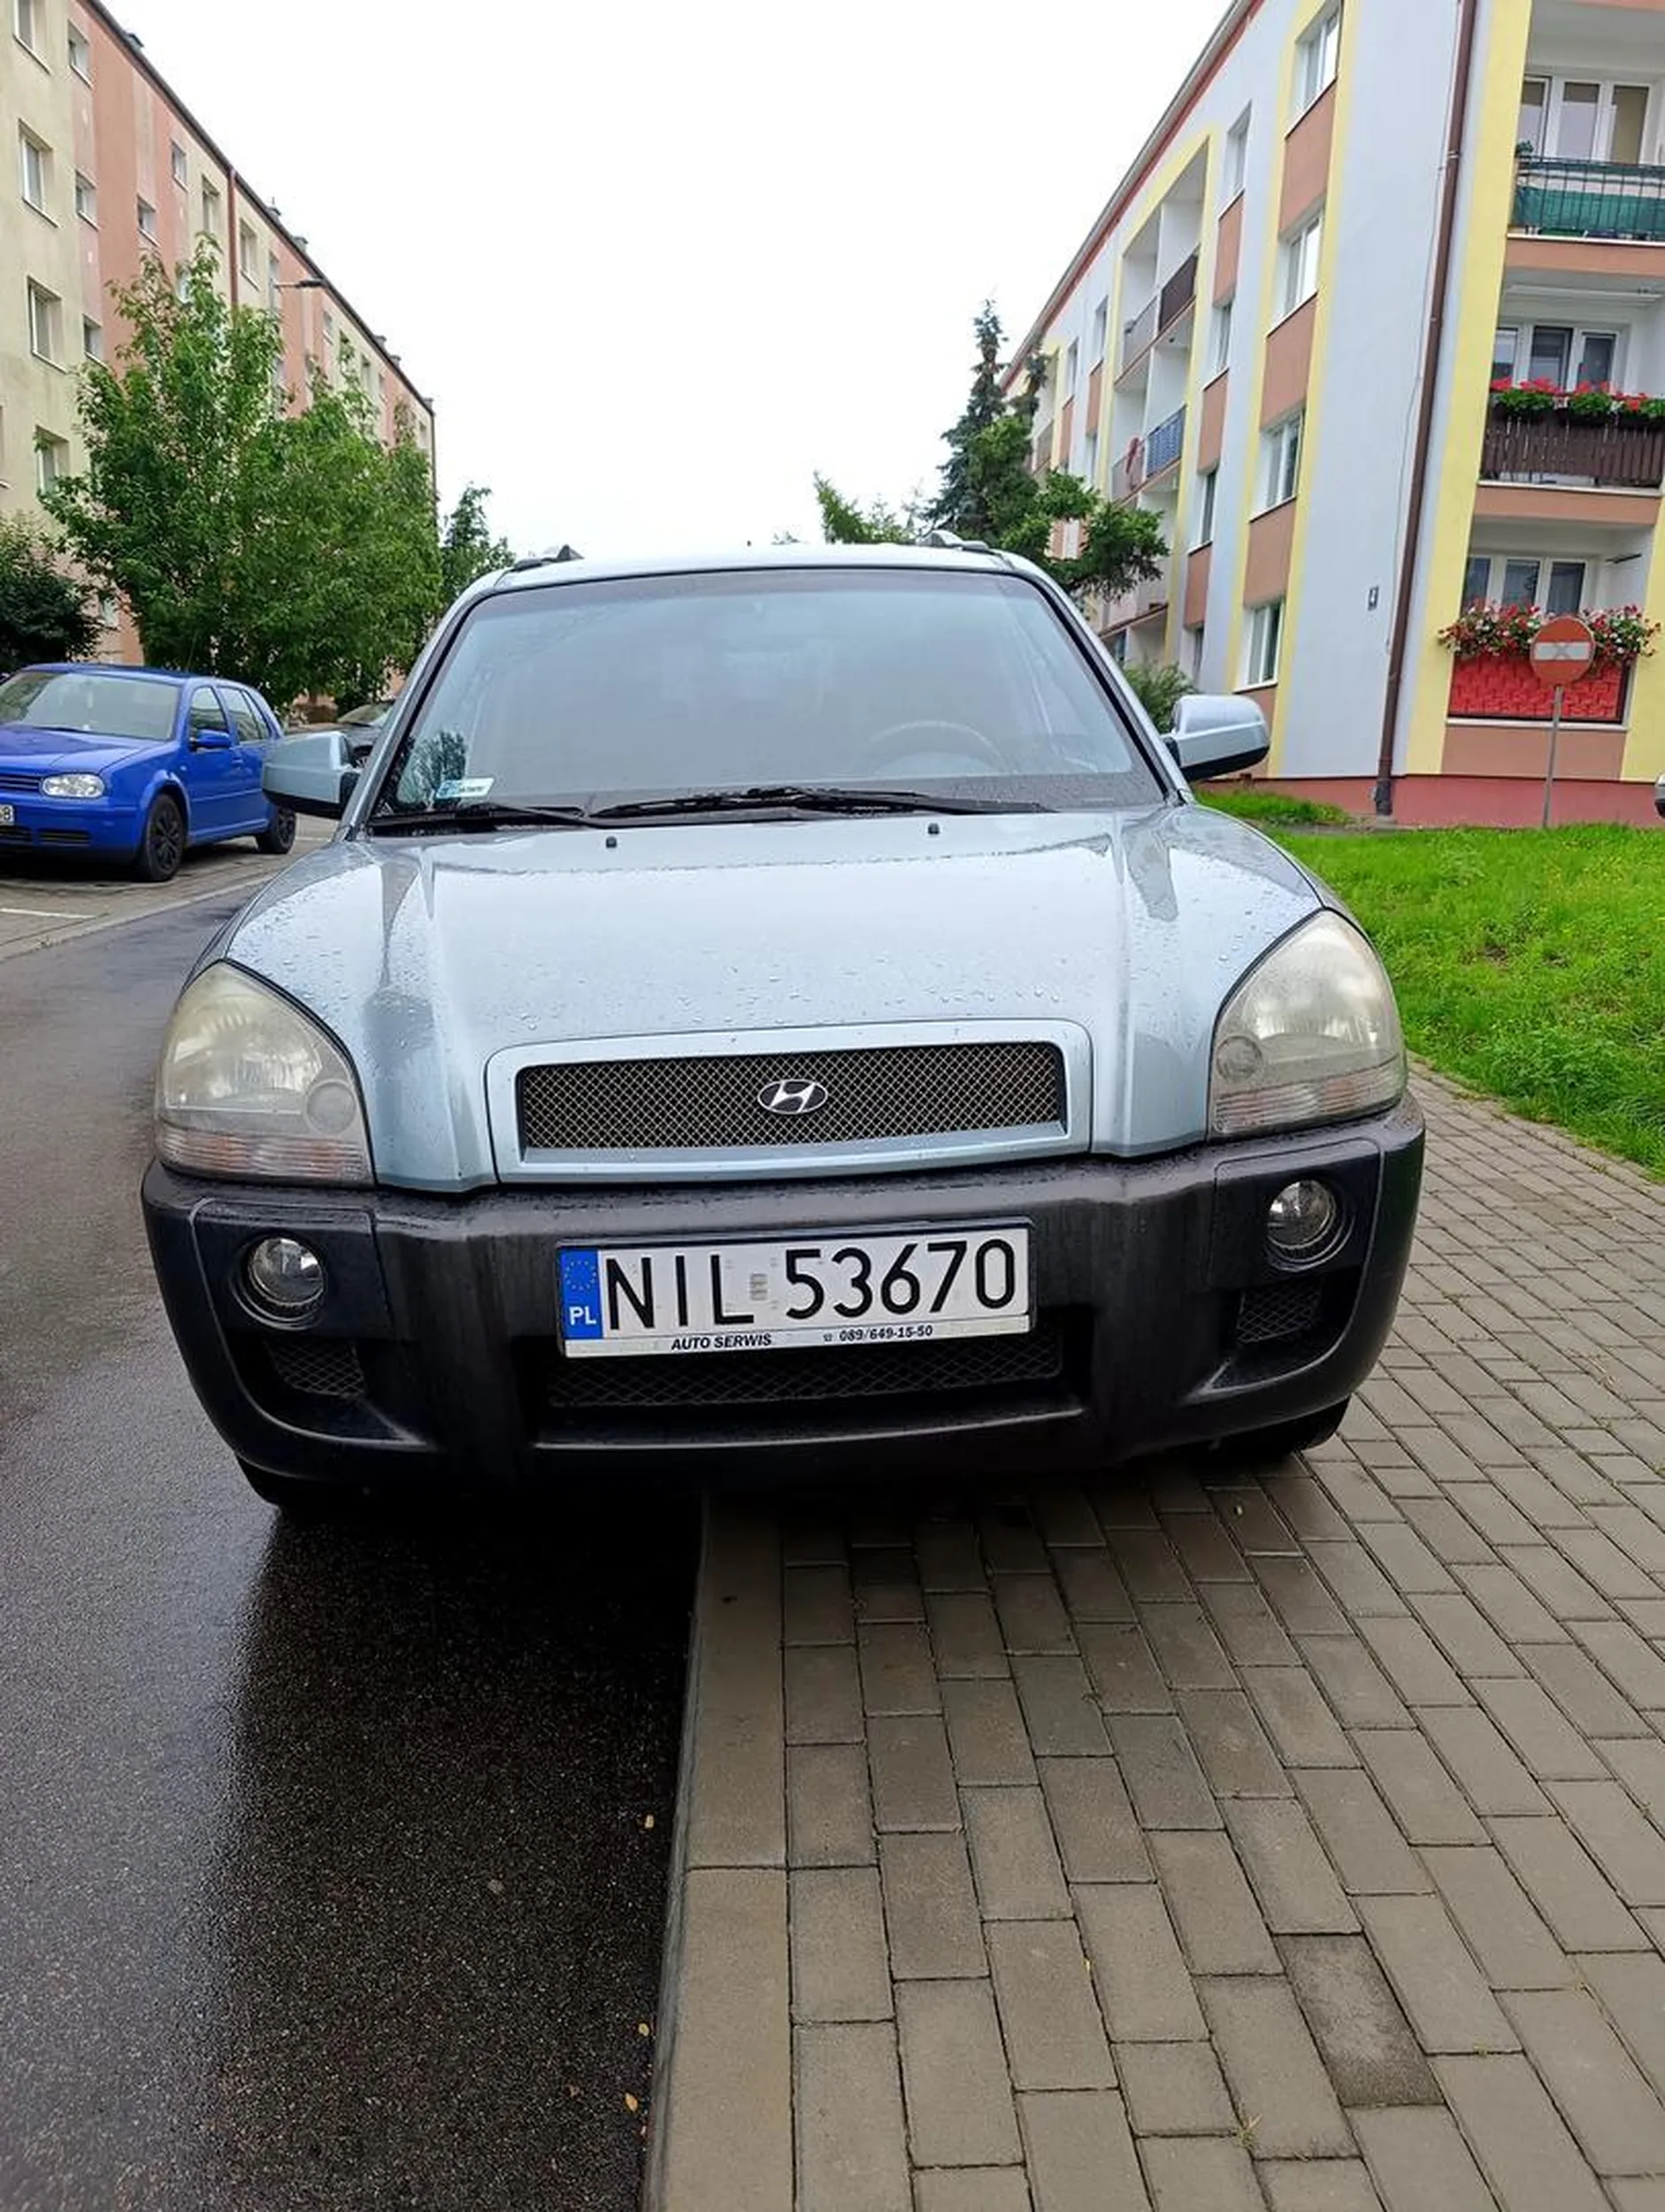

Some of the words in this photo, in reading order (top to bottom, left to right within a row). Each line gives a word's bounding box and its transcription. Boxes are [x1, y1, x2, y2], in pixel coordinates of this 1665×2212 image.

[605, 1254, 755, 1330] NIL
[785, 1239, 1016, 1320] 53670
[570, 1306, 596, 1326] PL
[671, 1335, 710, 1351] AUTO
[714, 1333, 772, 1349] SERWIS
[839, 1325, 933, 1342] 089/649-15-50
